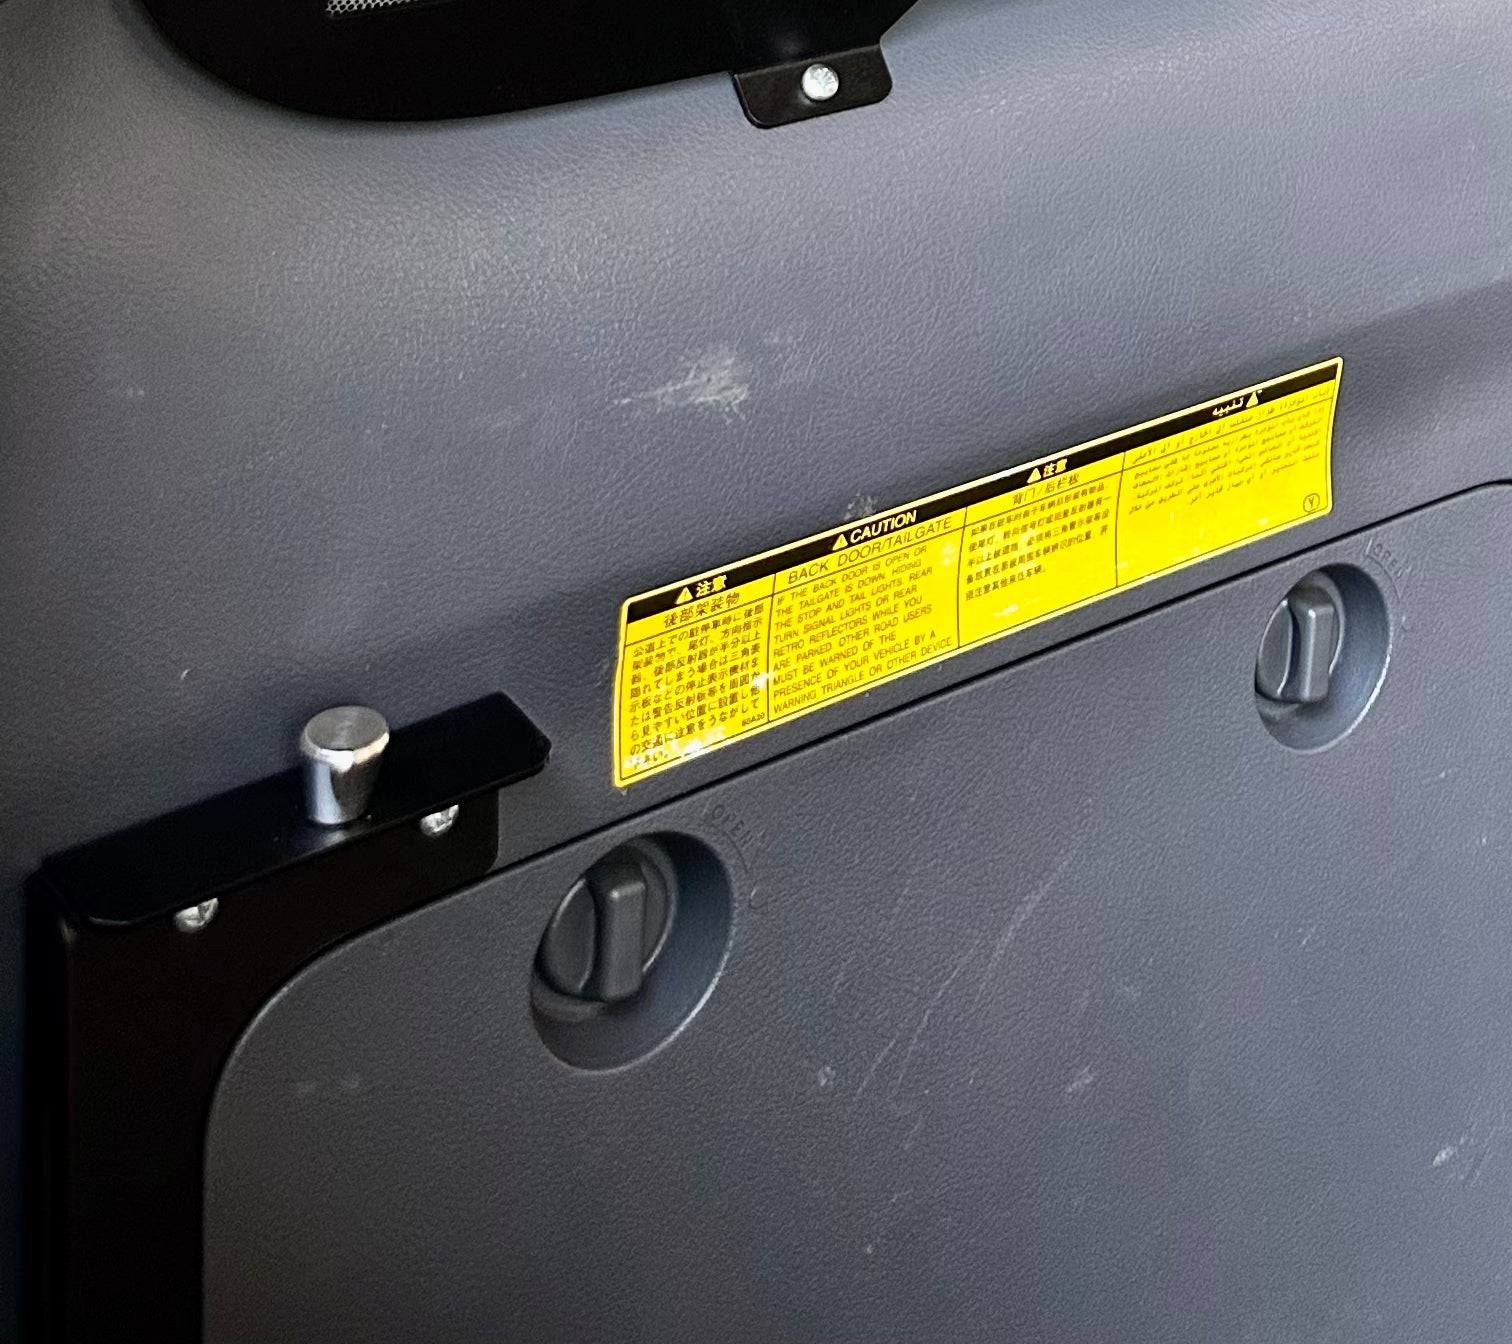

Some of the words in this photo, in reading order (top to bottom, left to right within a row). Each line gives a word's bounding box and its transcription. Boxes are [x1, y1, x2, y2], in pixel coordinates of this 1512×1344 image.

[1042, 457, 1067, 478] 注意
[787, 558, 829, 584] BACK
[837, 516, 952, 566] DOOR/TAILGATE
[849, 508, 917, 544] CAUTION
[695, 573, 727, 598] 注意
[775, 604, 793, 618] THE
[799, 588, 839, 609] TAILGATE
[891, 558, 921, 575] HIDING
[775, 617, 792, 631] THE
[797, 606, 821, 623] STOP
[826, 598, 844, 612] AND
[849, 590, 866, 603] TAIL
[909, 565, 932, 581] REAR
[790, 587, 807, 600] THE
[812, 577, 836, 592] BACK
[841, 566, 867, 581] DOOR
[885, 551, 909, 566] OPEN
[773, 638, 804, 658] RETRO
[809, 615, 867, 644] REFLECTORS
[872, 603, 898, 620] WHILE
[904, 594, 922, 608] YOU
[773, 657, 791, 671] ARE
[838, 627, 869, 647] OTHER
[873, 616, 898, 633] ROAD
[903, 603, 932, 622] USERS
[774, 627, 798, 644] TURN
[803, 614, 835, 633] SIGNAL
[840, 600, 871, 619] LIGHTS
[893, 583, 917, 599] REAR
[772, 668, 797, 686] MUST
[819, 644, 858, 668] WARNED
[879, 630, 896, 645] THE
[773, 672, 821, 700] PRESENCE
[843, 654, 869, 673] YOUR
[873, 638, 909, 661] VEHICLE
[773, 688, 817, 714] WARNING
[820, 670, 864, 695] TRIANGLE
[886, 649, 916, 669] OTHER
